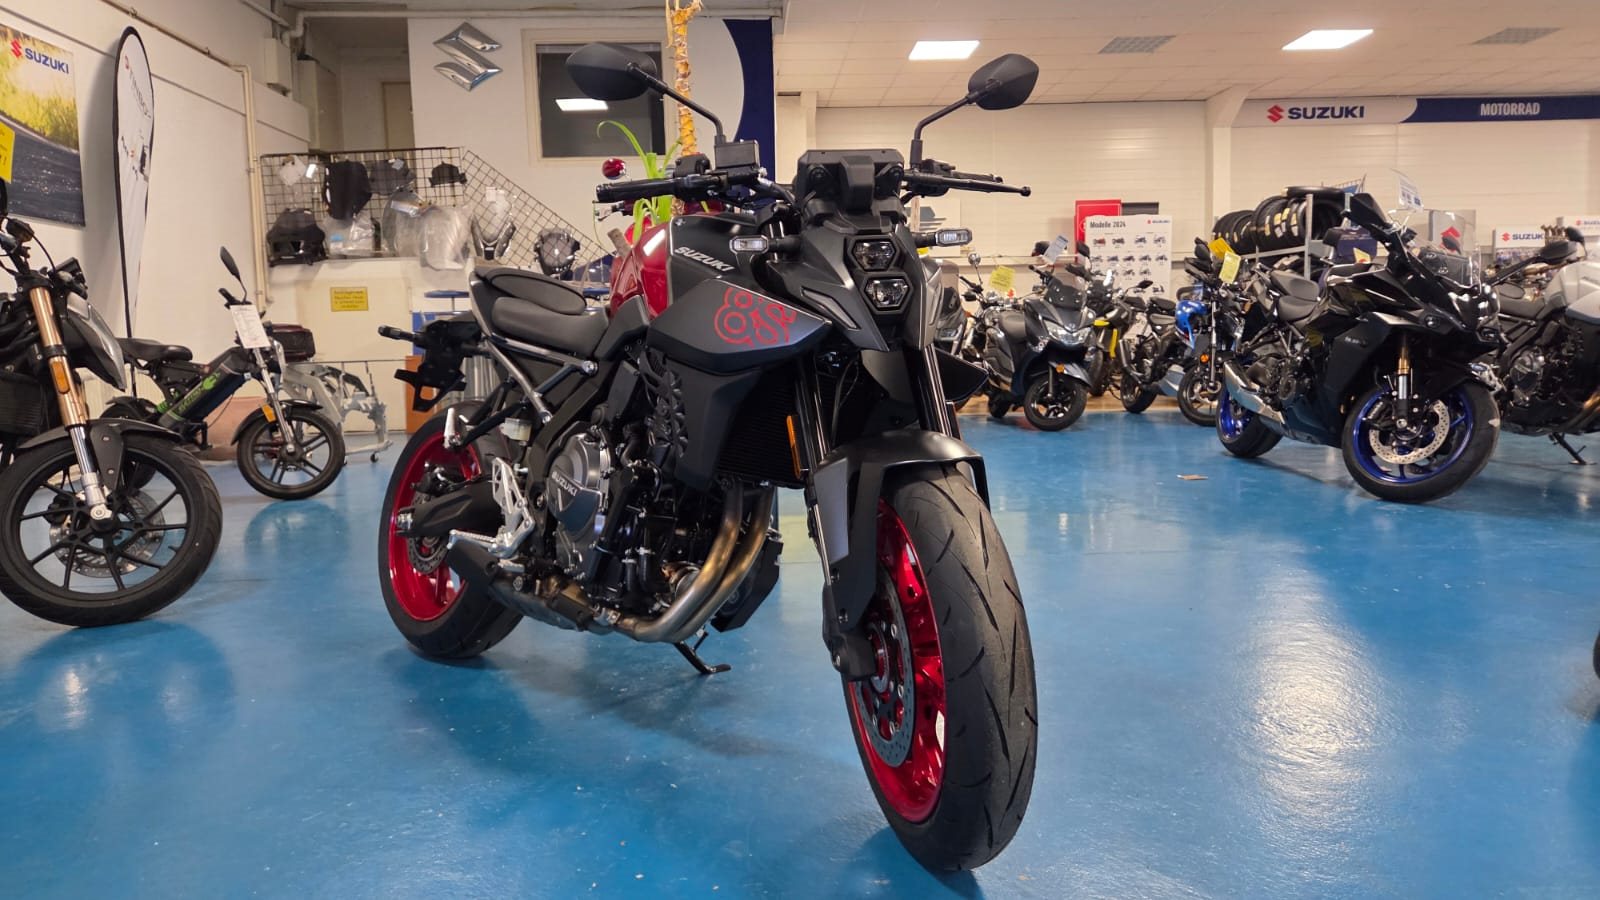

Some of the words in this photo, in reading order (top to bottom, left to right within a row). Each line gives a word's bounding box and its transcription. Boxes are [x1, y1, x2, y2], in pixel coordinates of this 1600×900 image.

[25, 47, 70, 74] SUZUKI
[1287, 105, 1365, 119] SUZUKI
[1480, 102, 1541, 116] MOTORRAD
[674, 246, 735, 272] SUZUKI
[551, 470, 578, 497] SUZUKI
